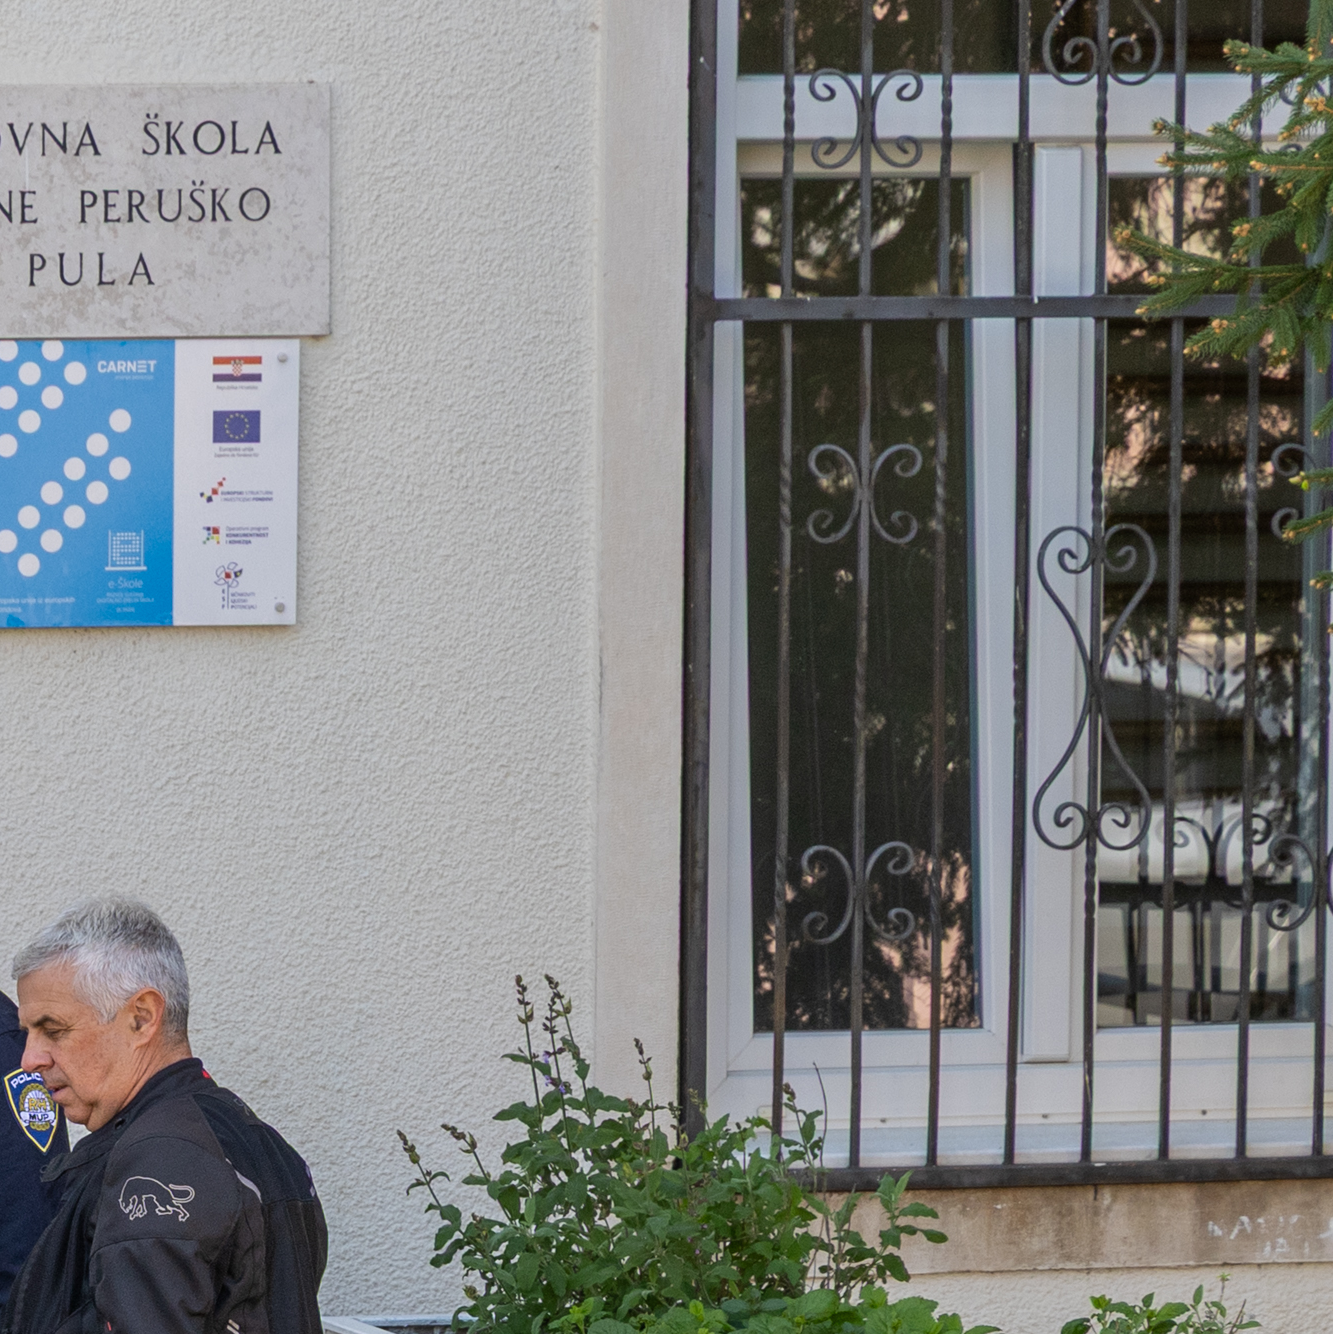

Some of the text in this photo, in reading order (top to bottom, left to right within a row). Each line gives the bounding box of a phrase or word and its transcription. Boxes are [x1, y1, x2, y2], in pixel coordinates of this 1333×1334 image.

[141, 113, 283, 155] ŠKOLA
[79, 181, 271, 224] PERUŠKO
[29, 252, 155, 287] PULA
[97, 360, 157, 373] CARNET
[108, 576, 144, 589] e-Škole
[10, 1072, 43, 1089] POLIC
[29, 1113, 49, 1121] MUP
